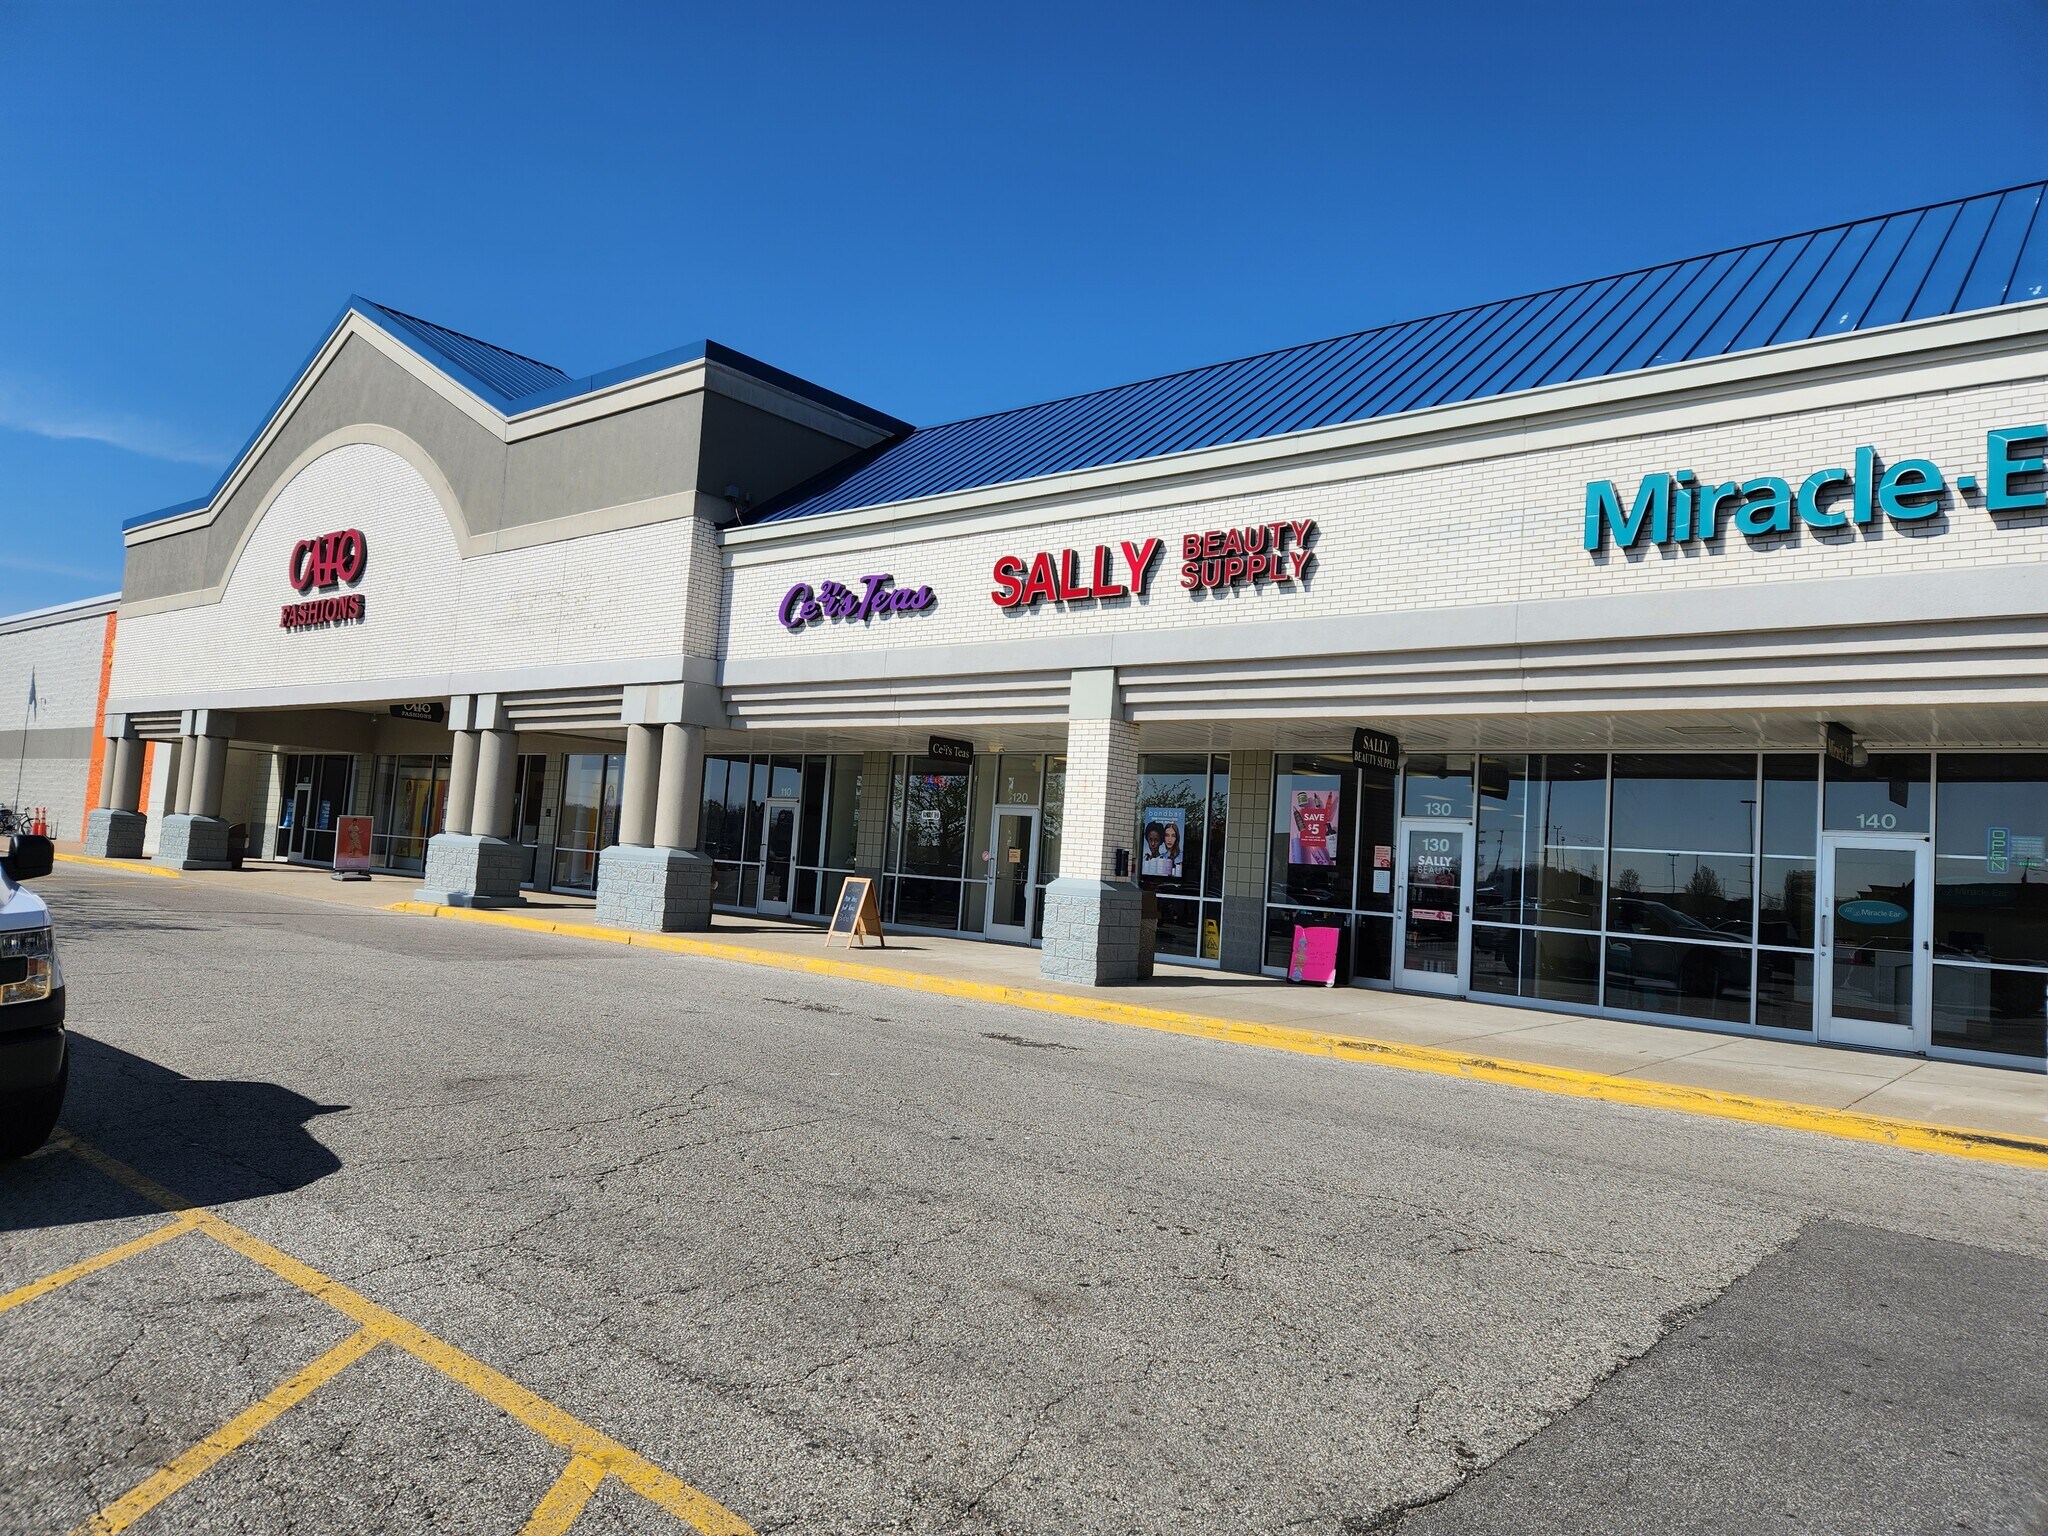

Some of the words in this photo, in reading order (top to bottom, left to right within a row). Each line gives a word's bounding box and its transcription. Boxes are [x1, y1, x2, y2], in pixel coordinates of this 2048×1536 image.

[1183, 519, 1314, 561] BEAUTY
[289, 528, 364, 590] CATO
[991, 538, 1162, 608] SALLY
[1181, 551, 1315, 589] SUPPLY
[858, 573, 933, 621] Teas
[279, 594, 362, 629] FASHIONS
[954, 747, 970, 759] Teas
[1363, 735, 1390, 755] SALLY
[1354, 750, 1377, 765] BEAUTY
[1377, 756, 1397, 770] SUPPLY
[781, 787, 792, 797] 110
[1012, 792, 1029, 803] 120
[1425, 802, 1452, 816] 130
[1304, 813, 1325, 822] SAVE
[1856, 813, 1897, 829] 140
[1308, 823, 1320, 835] $5
[1423, 838, 1450, 852] 130
[1991, 830, 2006, 871] OPEN
[1418, 855, 1453, 867] SALLY
[1417, 865, 1453, 875] BEAUTY
